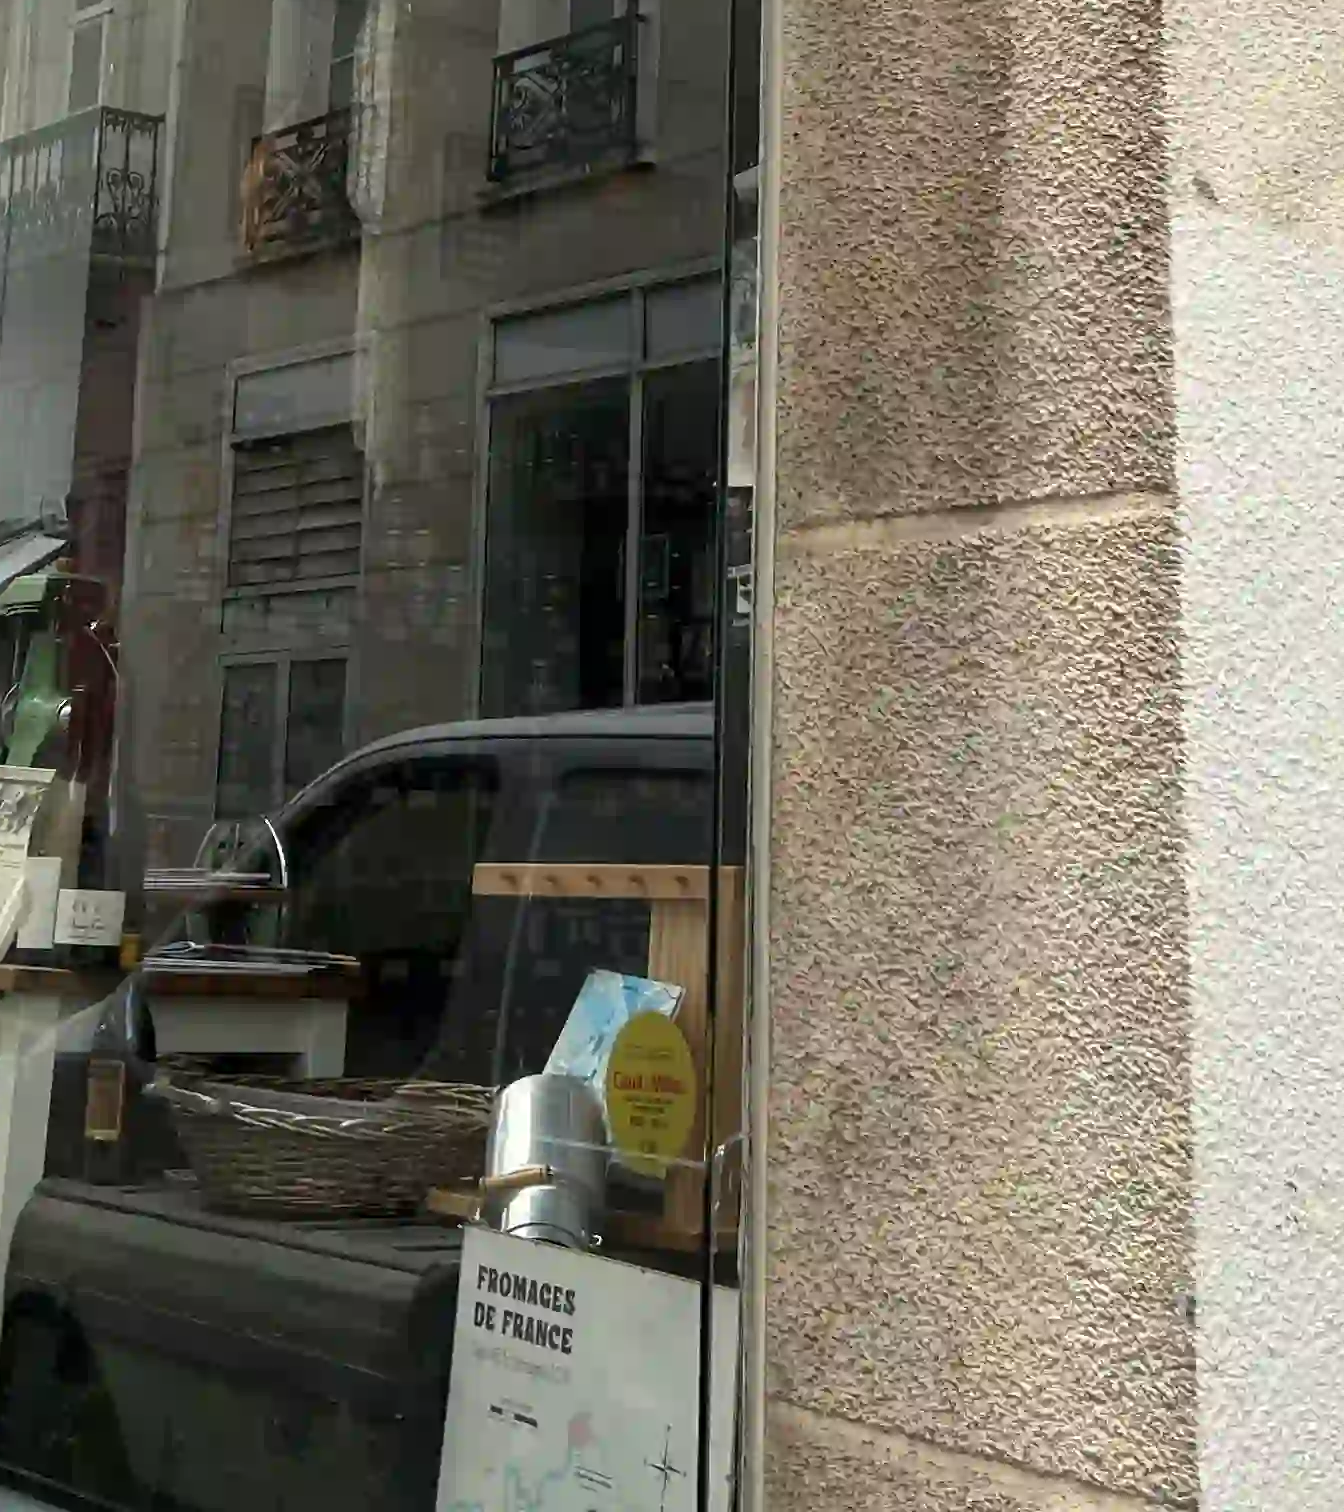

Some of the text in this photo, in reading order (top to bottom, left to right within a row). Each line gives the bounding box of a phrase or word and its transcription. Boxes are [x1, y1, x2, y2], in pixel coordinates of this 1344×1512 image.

[477, 1264, 576, 1316] FROMAGES
[474, 1301, 573, 1355] DE FRANCE
